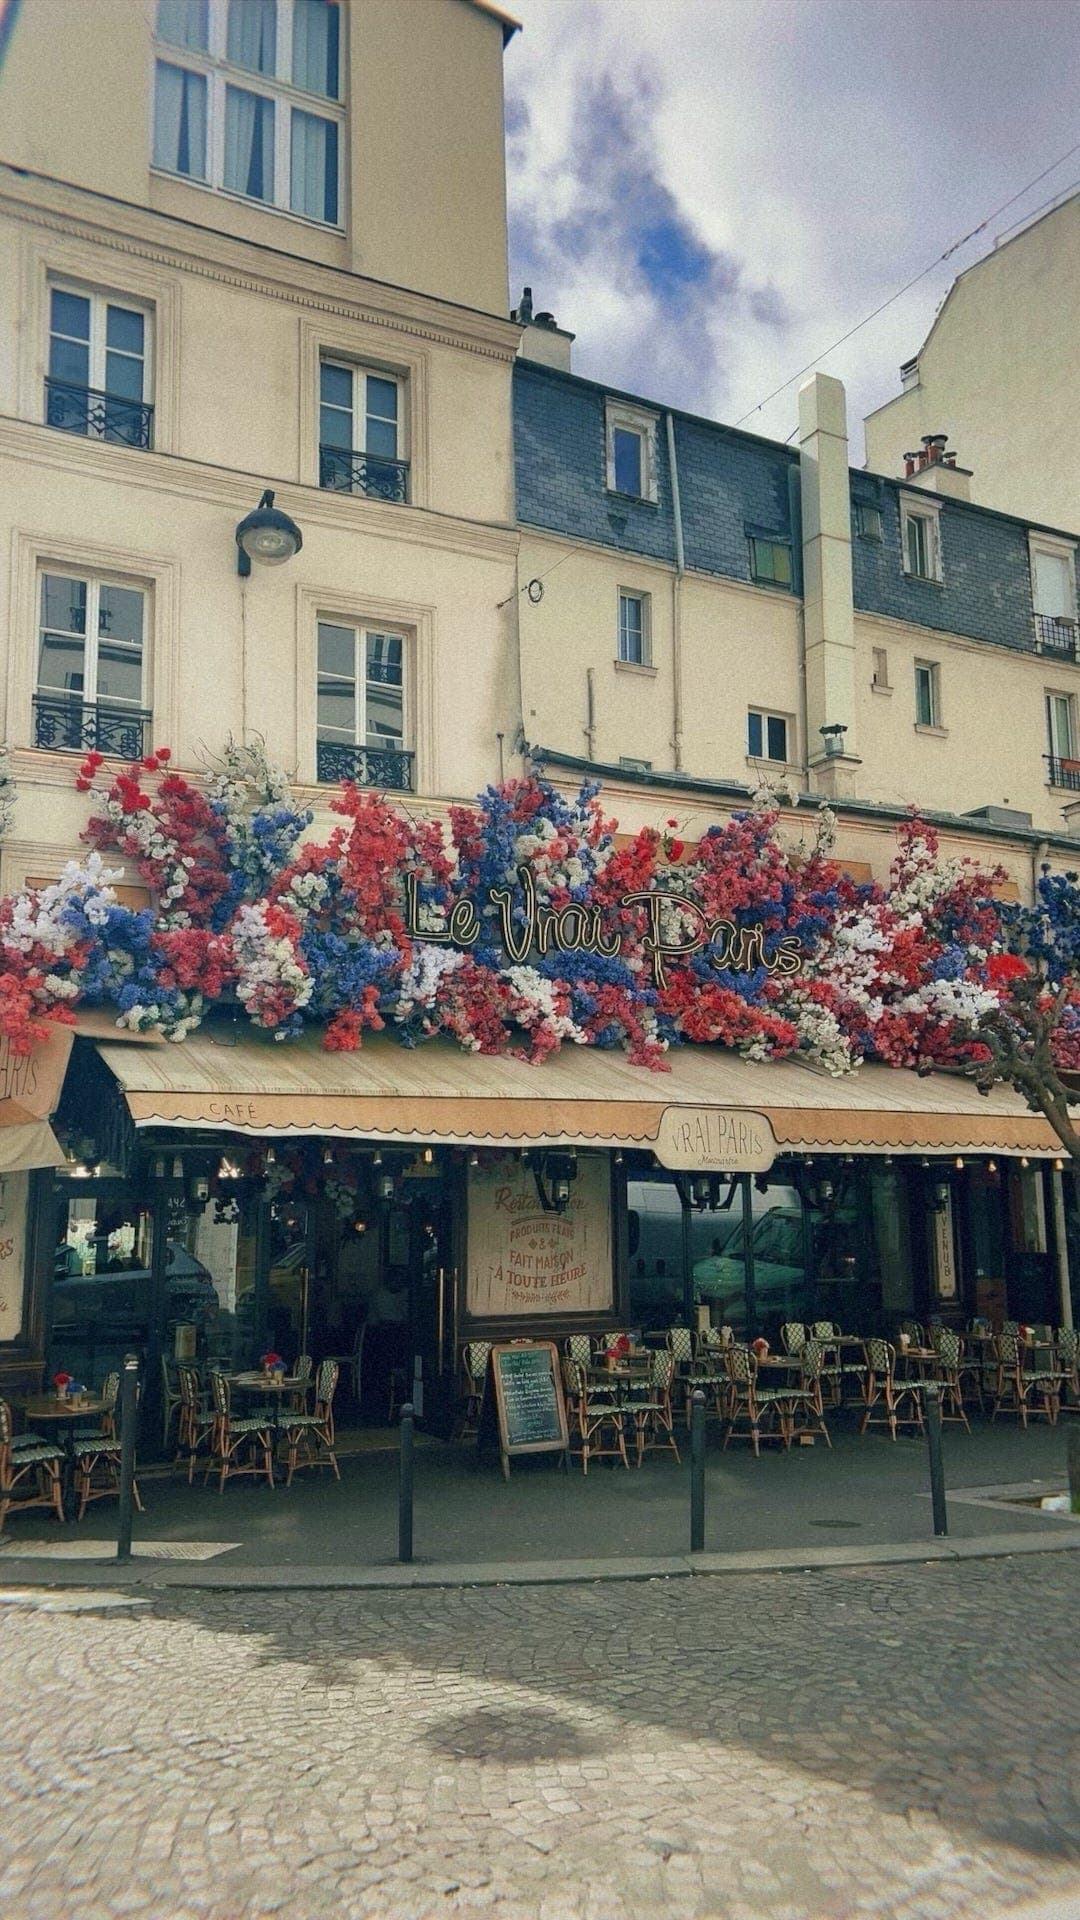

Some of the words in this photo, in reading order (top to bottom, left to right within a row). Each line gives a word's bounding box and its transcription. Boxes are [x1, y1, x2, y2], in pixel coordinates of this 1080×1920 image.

[406, 871, 480, 945] Le
[489, 866, 622, 963] Vrai
[621, 889, 801, 991] Paris
[209, 1102, 258, 1119] CAFÉ
[671, 1115, 711, 1153] VRAI
[718, 1115, 763, 1155] PARIS
[509, 1250, 533, 1270] FAIT
[535, 1248, 574, 1271] MAISON
[506, 1270, 548, 1289] TOUTE
[550, 1262, 588, 1287] HEURE
